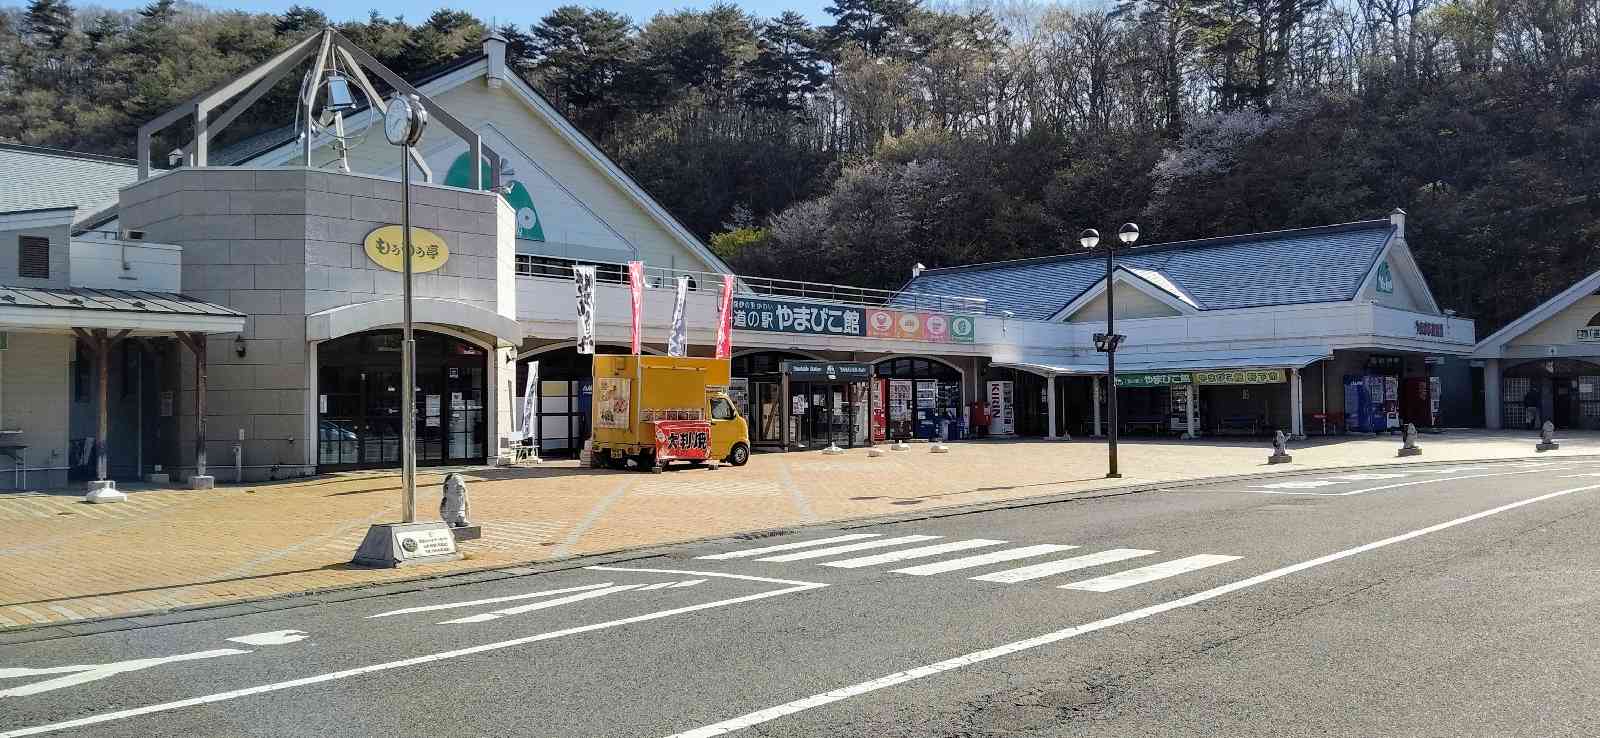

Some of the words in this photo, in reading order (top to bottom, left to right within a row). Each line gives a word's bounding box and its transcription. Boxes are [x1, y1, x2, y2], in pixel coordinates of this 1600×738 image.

[734, 309, 774, 329] 道の駅
[776, 305, 860, 334] やまびこ館
[991, 383, 1001, 418] KIRIN
